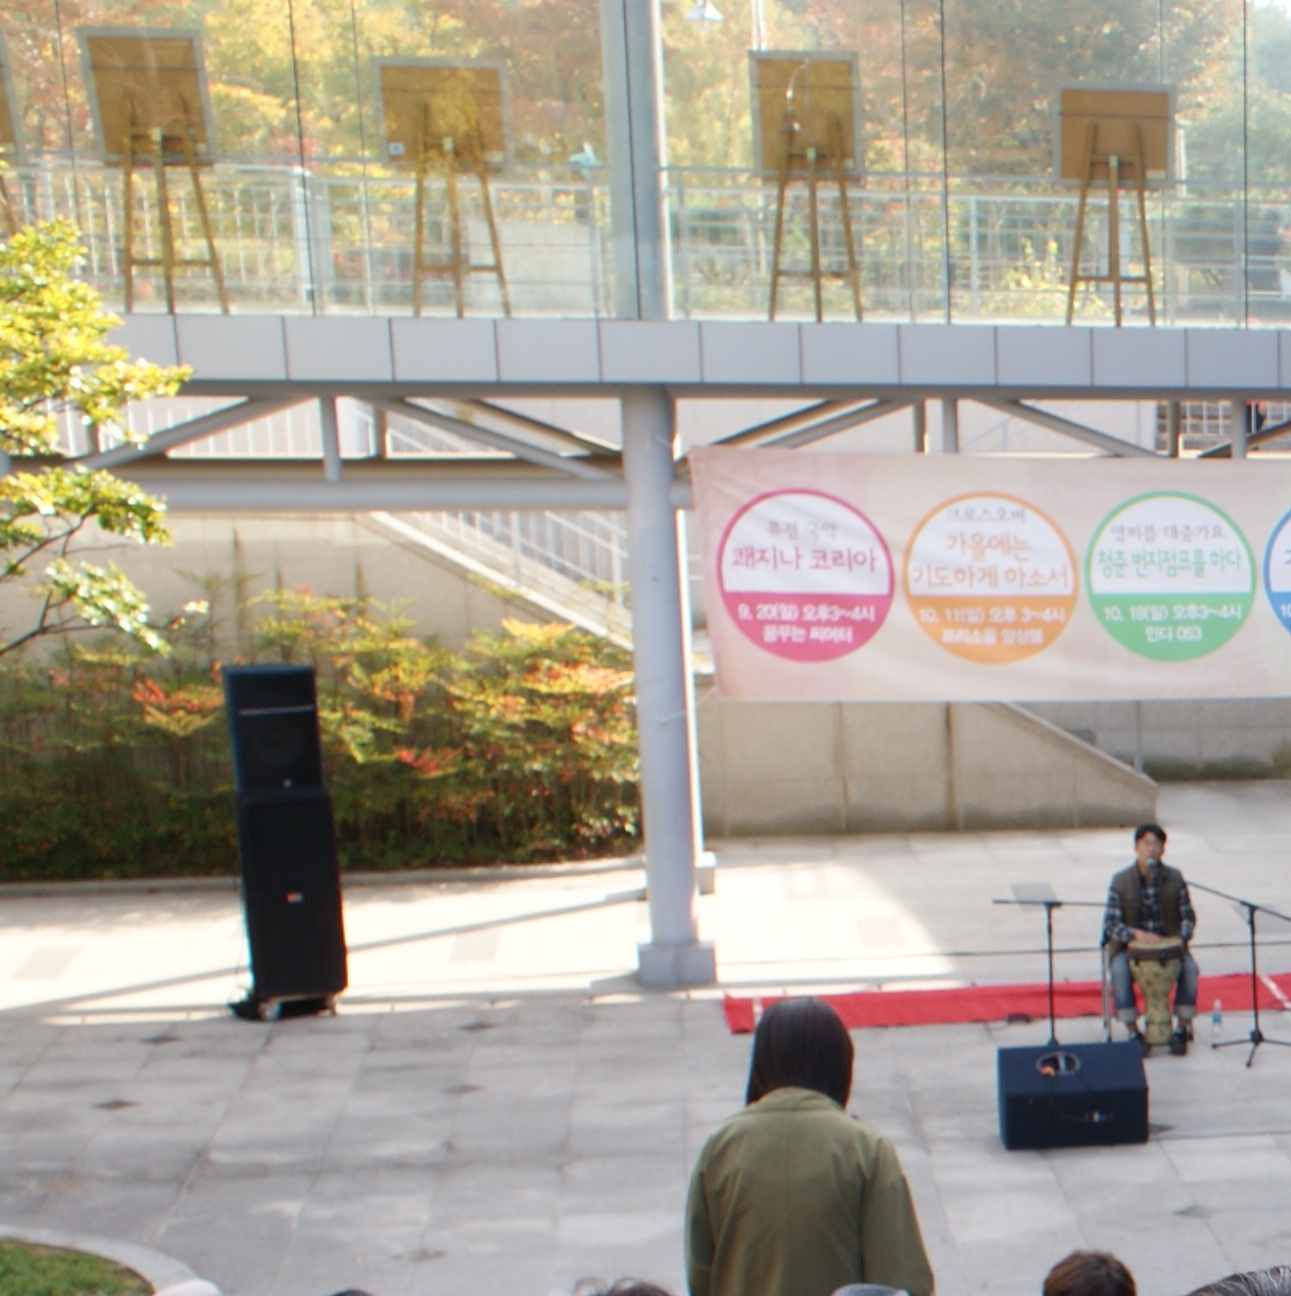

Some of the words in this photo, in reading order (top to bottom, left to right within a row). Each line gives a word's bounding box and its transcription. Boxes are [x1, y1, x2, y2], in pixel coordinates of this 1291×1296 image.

[808, 547, 877, 573] 코리아
[947, 531, 1032, 562] 가을에는
[912, 563, 998, 588] 기도하게
[1004, 564, 1068, 588] 아소서
[1097, 548, 1128, 578] 청춘
[1131, 547, 1206, 578] 번지점프를
[1209, 547, 1242, 571] 하다
